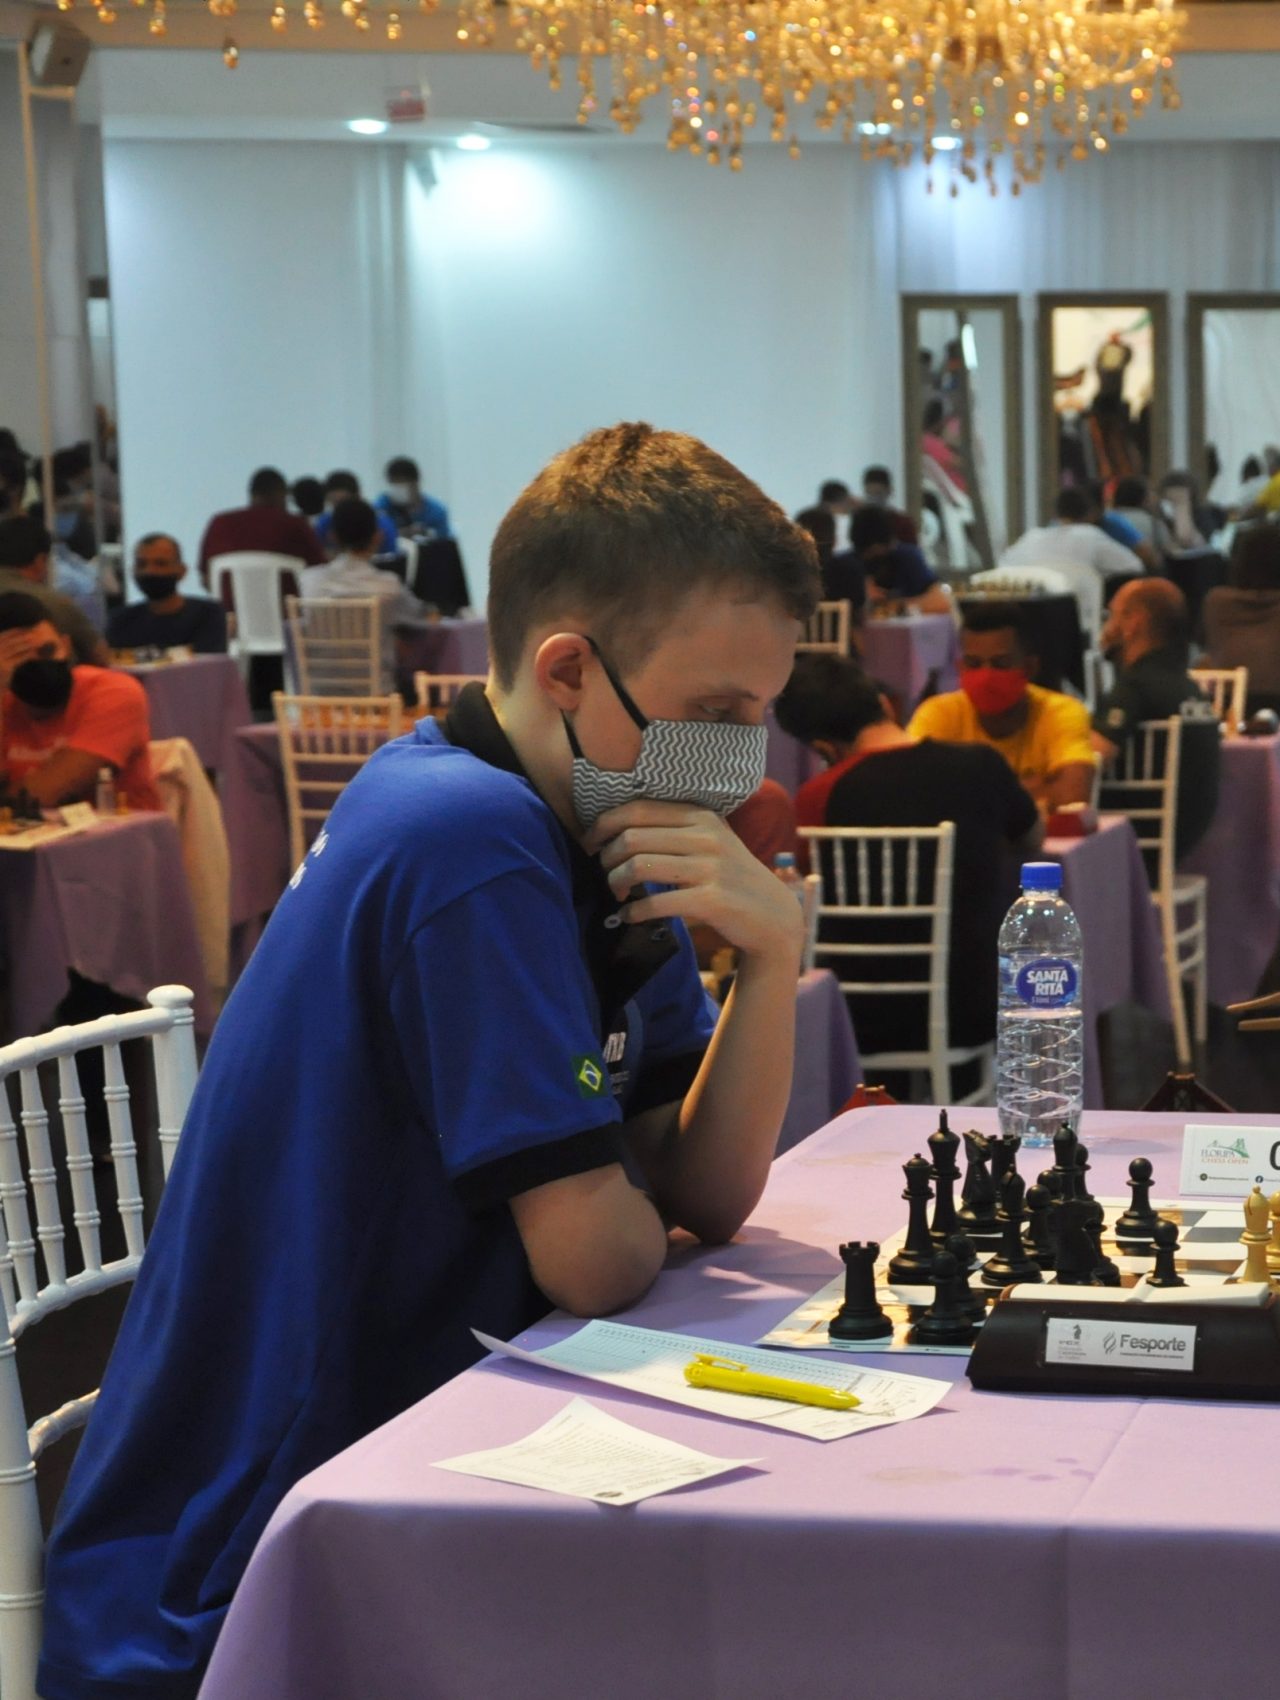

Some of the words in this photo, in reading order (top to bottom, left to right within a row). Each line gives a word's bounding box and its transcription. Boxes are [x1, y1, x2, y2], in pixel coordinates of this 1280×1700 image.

[1026, 970, 1069, 983] SANTA
[1034, 982, 1064, 995] RITA
[1201, 1149, 1235, 1158] FLORIPA
[1120, 1334, 1186, 1352] Fesporte
